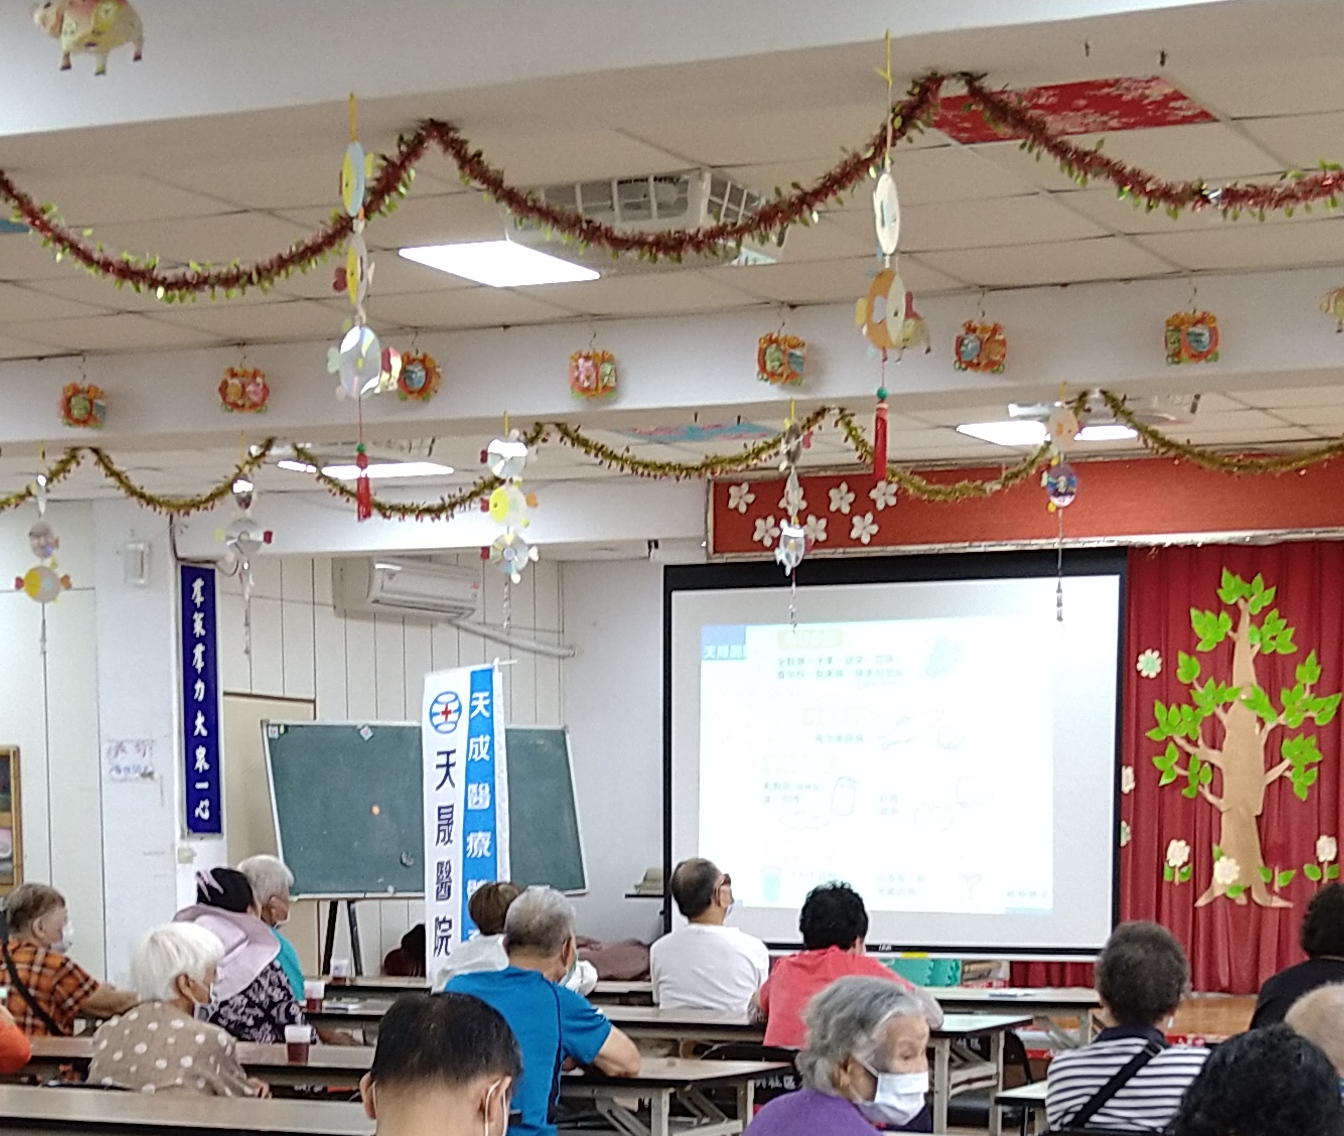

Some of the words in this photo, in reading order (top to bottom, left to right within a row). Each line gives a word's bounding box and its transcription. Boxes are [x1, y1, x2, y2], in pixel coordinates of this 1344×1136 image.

[433, 748, 456, 958] 天晟醫院
[466, 691, 492, 940] 天成醫療
